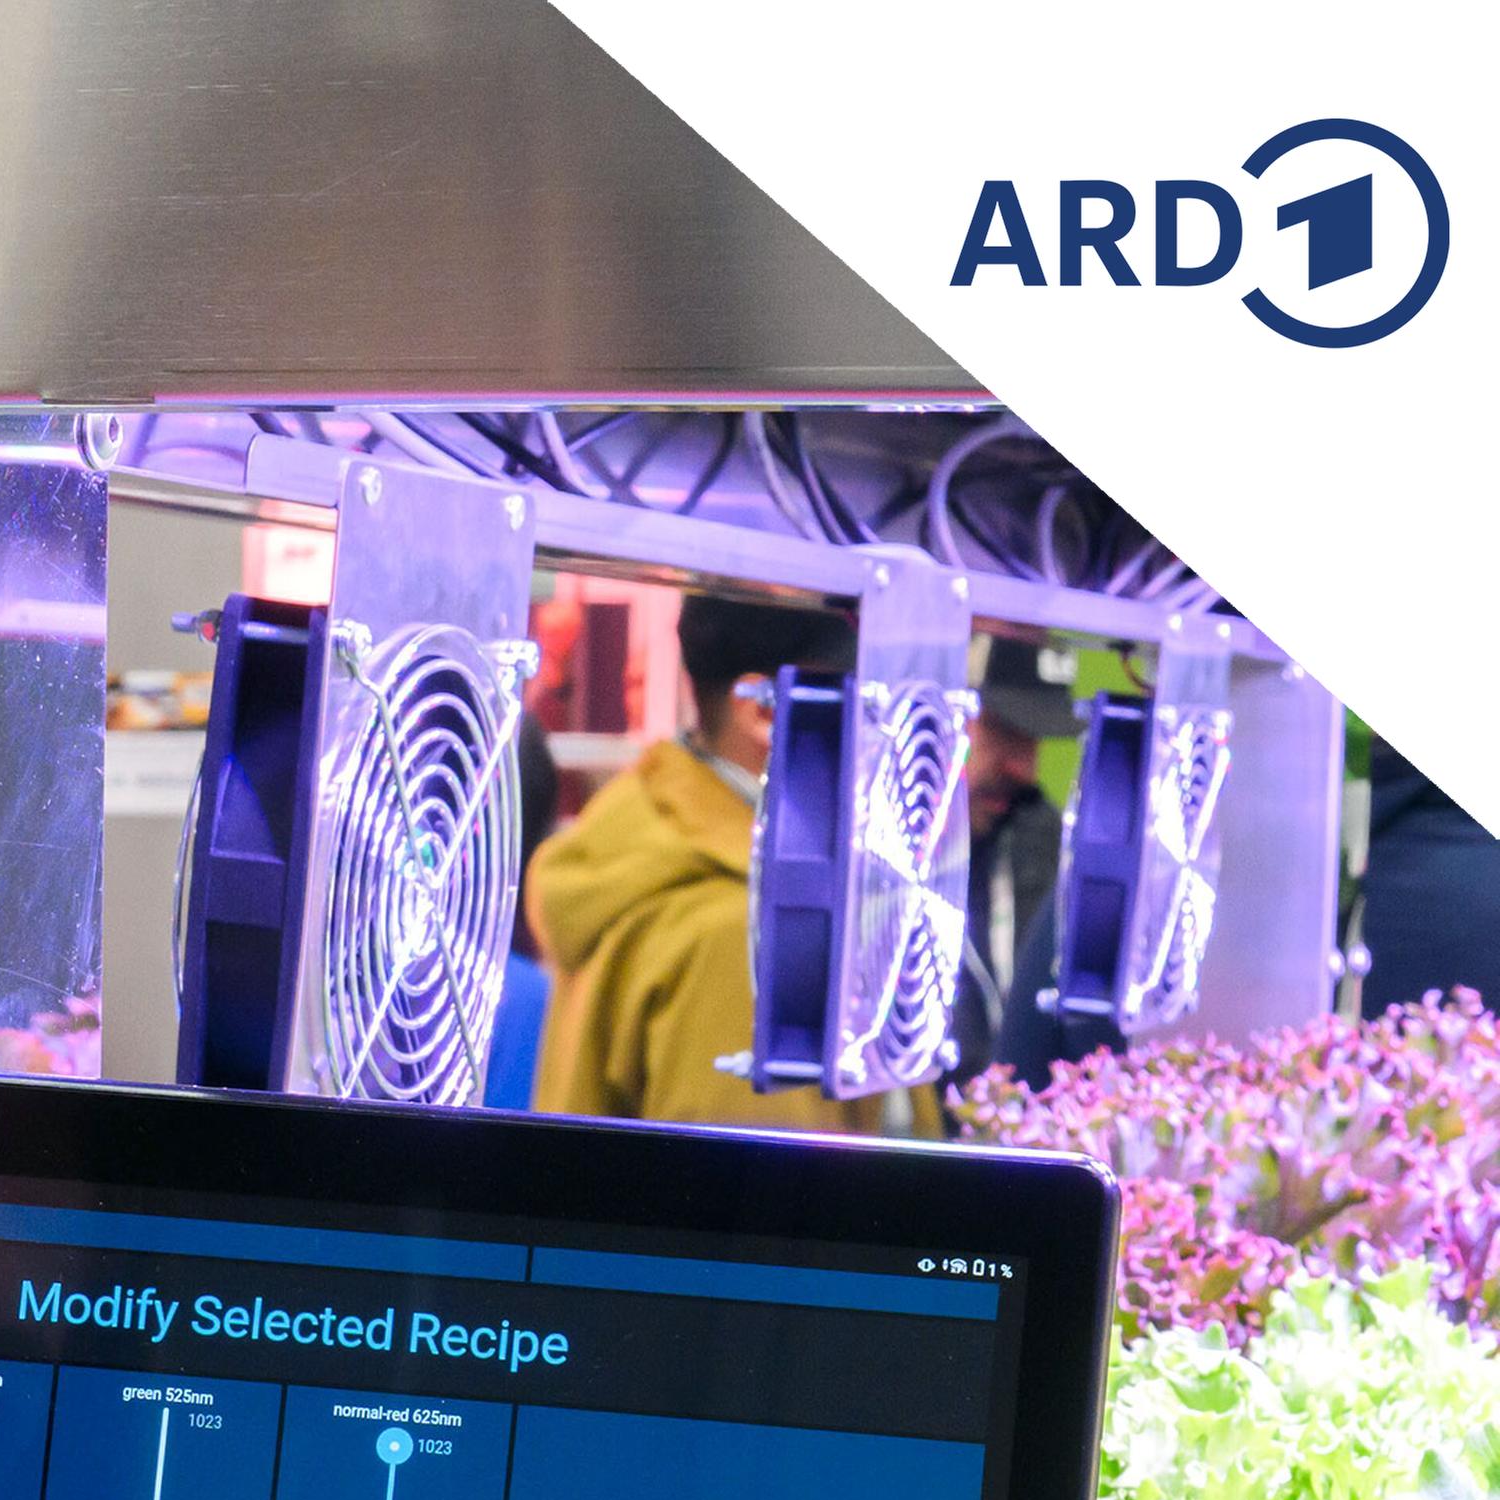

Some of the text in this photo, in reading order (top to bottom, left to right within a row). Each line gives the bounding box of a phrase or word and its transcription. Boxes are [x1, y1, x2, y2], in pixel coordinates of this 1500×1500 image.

[18, 1279, 569, 1373] Modify Selected Recipe
[122, 1386, 214, 1406] green 525nm
[188, 1413, 223, 1430] 1023
[333, 1405, 462, 1427] normal-red 625nm
[418, 1438, 453, 1456] 1023
